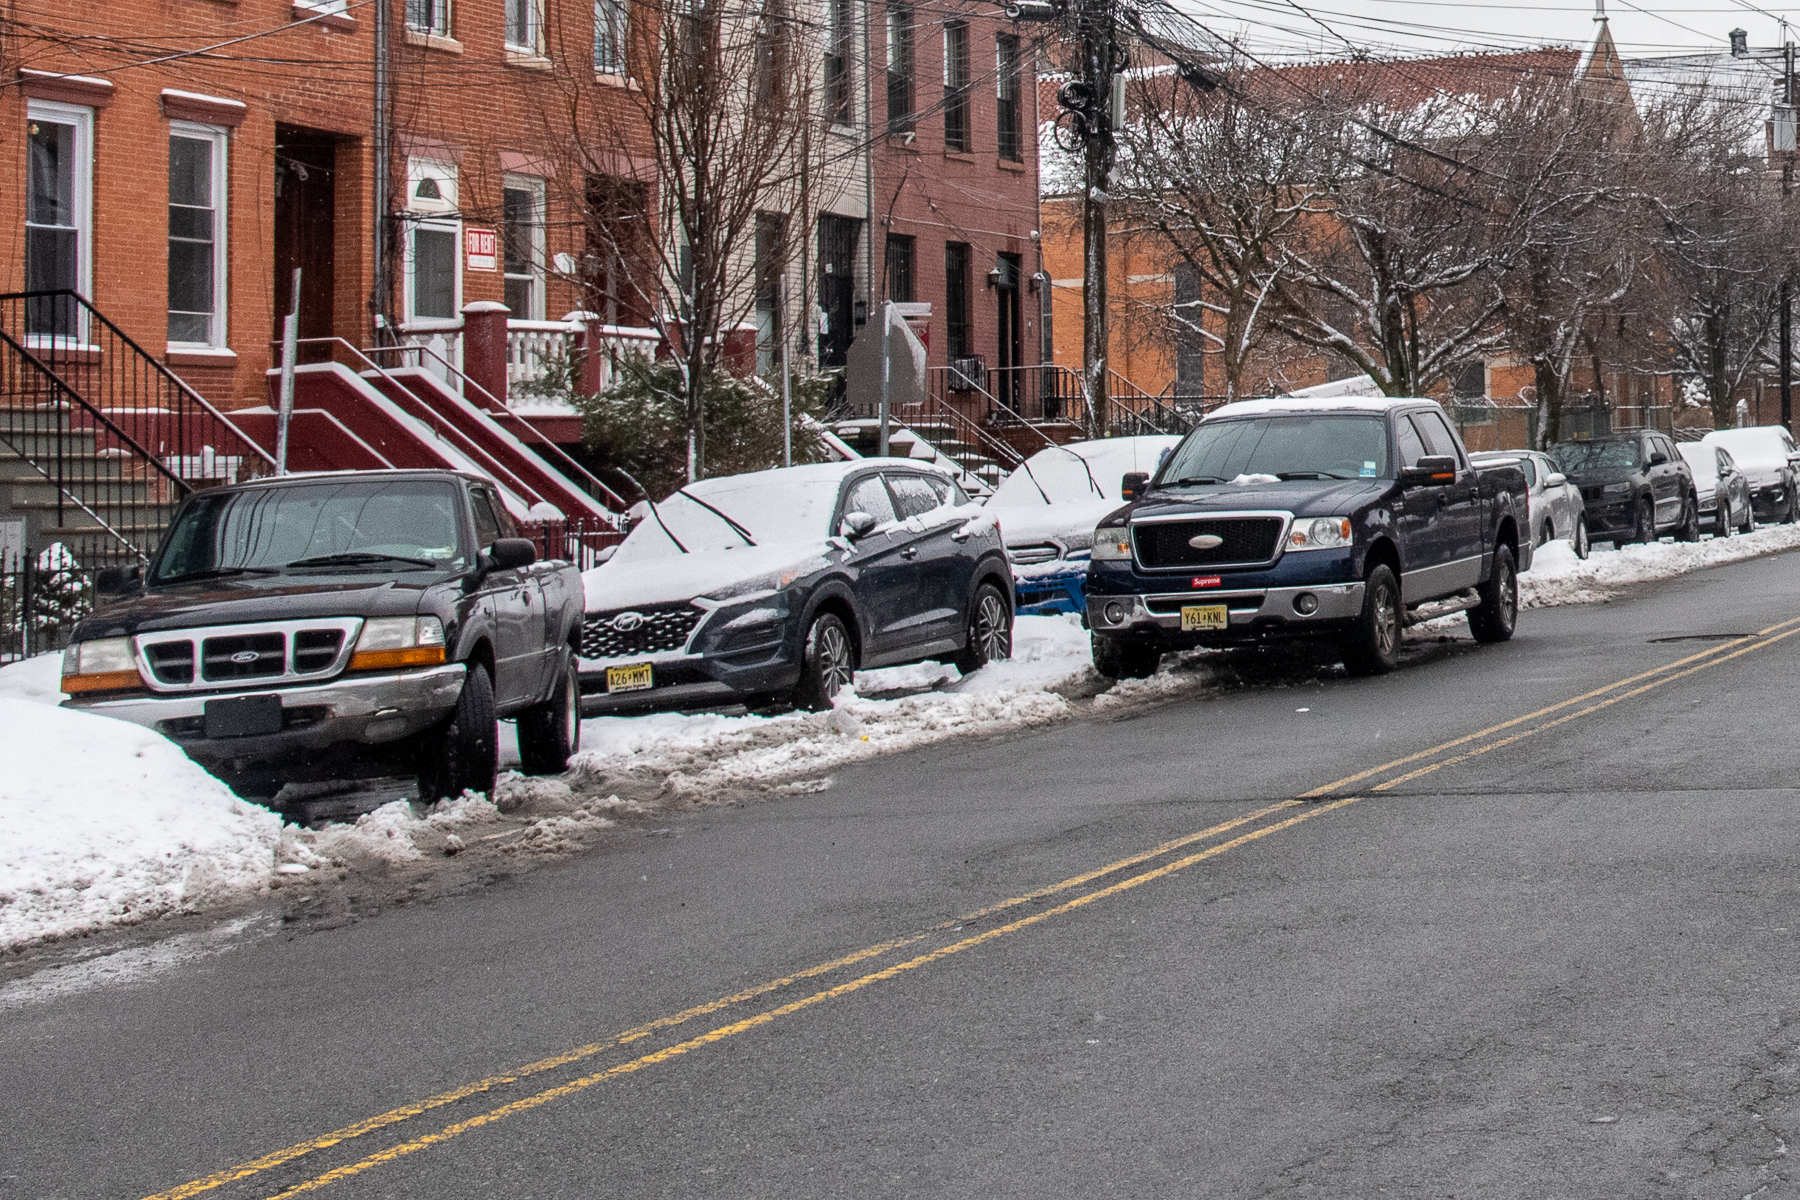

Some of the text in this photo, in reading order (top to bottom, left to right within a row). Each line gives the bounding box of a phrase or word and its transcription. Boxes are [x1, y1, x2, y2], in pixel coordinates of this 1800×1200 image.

[468, 232, 495, 254] FOR RENT
[1194, 577, 1221, 587] Supreme
